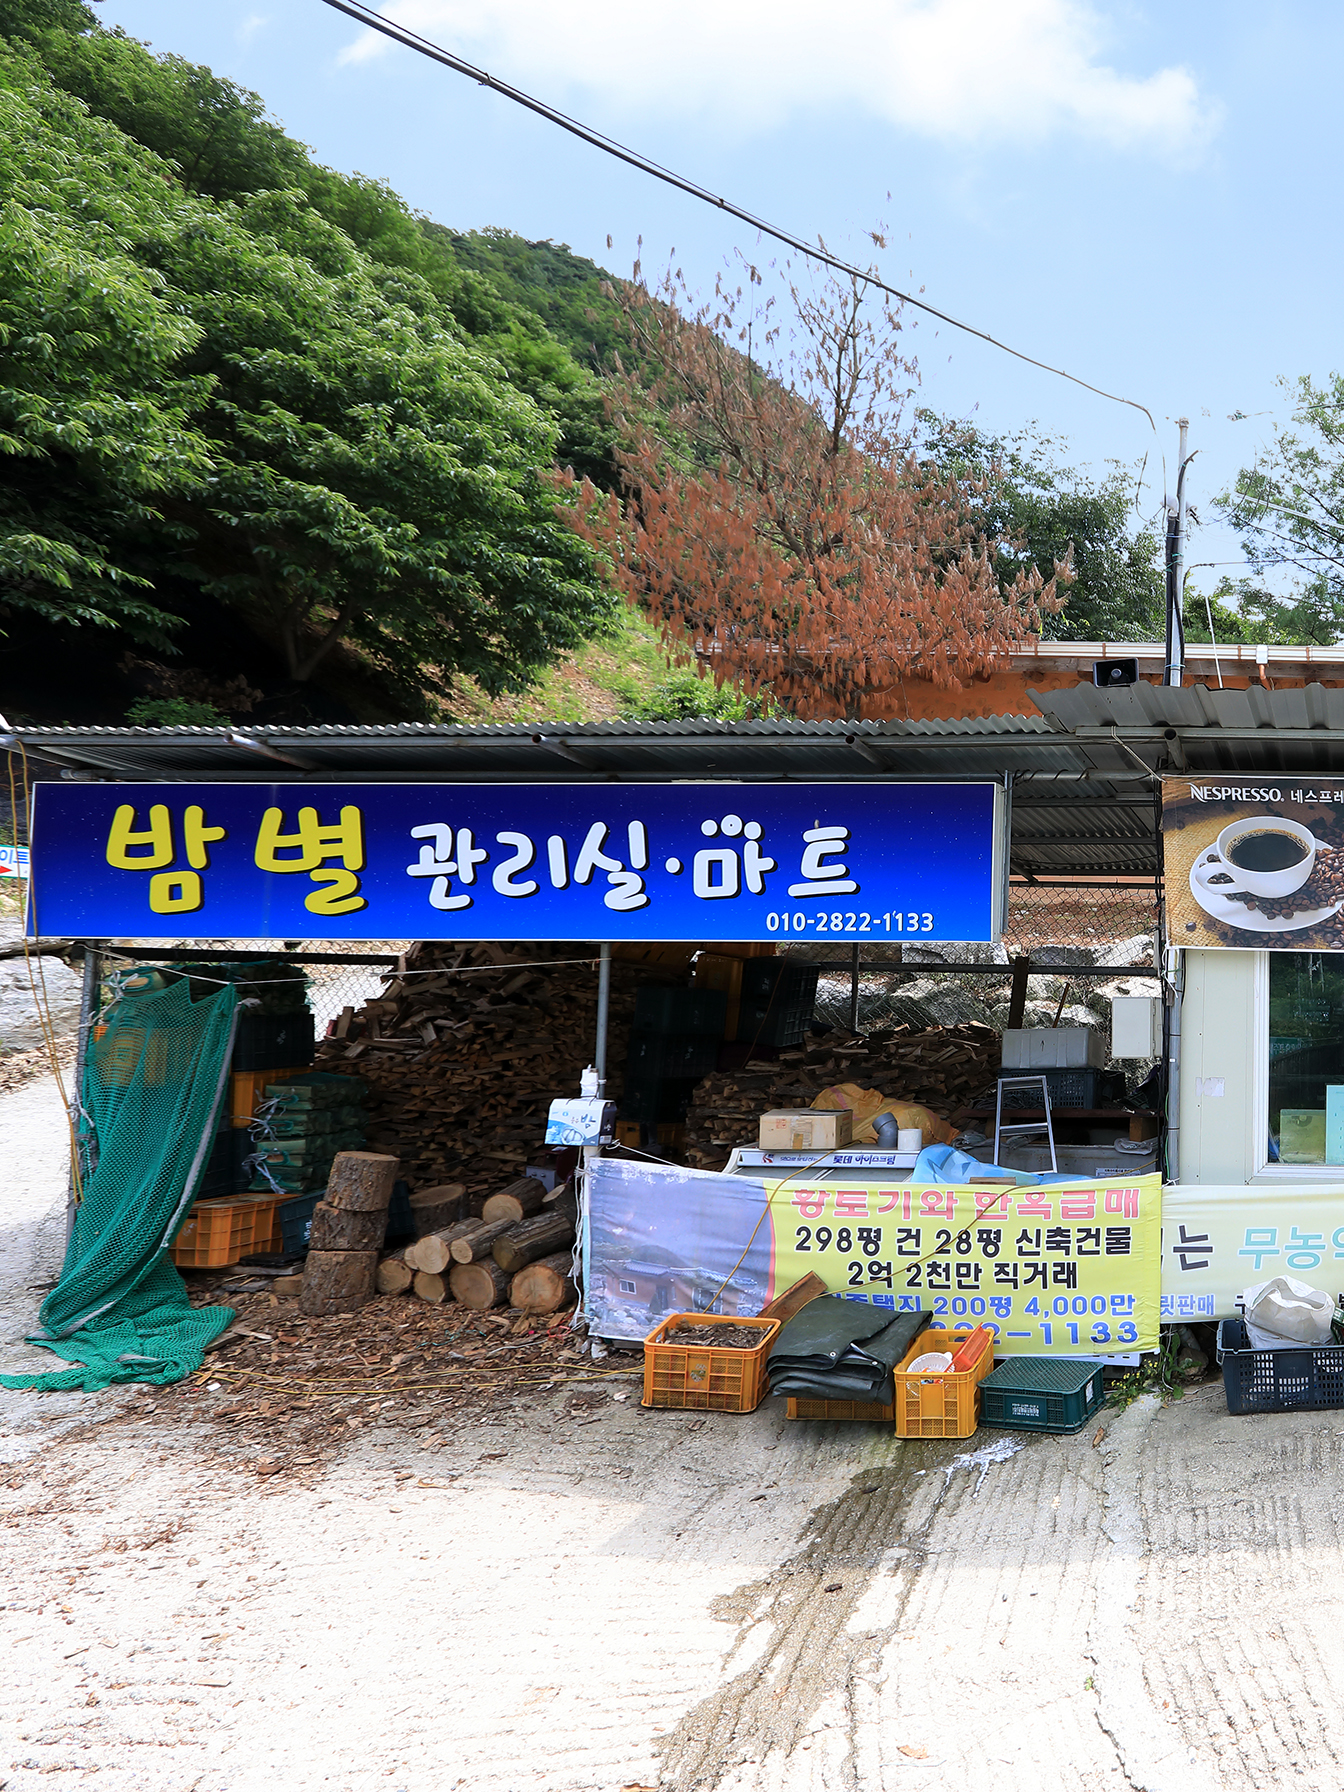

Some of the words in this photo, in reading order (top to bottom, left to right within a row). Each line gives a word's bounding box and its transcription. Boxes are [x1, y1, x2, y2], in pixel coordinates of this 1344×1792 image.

[1188, 783, 1281, 802] NESPRESSO
[766, 912, 934, 932] 010-2822-1133
[832, 1155, 852, 1164] 롯데
[854, 1153, 896, 1165] 아이스크림
[791, 1188, 958, 1221] 황토기와
[974, 1189, 1140, 1220] 한옥급매
[795, 1225, 882, 1257] 298평
[896, 1228, 922, 1257] 건
[935, 1227, 1002, 1259] 28평
[1015, 1226, 1132, 1257] 신축건물
[847, 1260, 893, 1289] 2억
[906, 1261, 982, 1290] 2천만
[994, 1261, 1078, 1290] 직거래
[933, 1295, 1013, 1319] 200평
[1025, 1293, 1136, 1318] 4,000만
